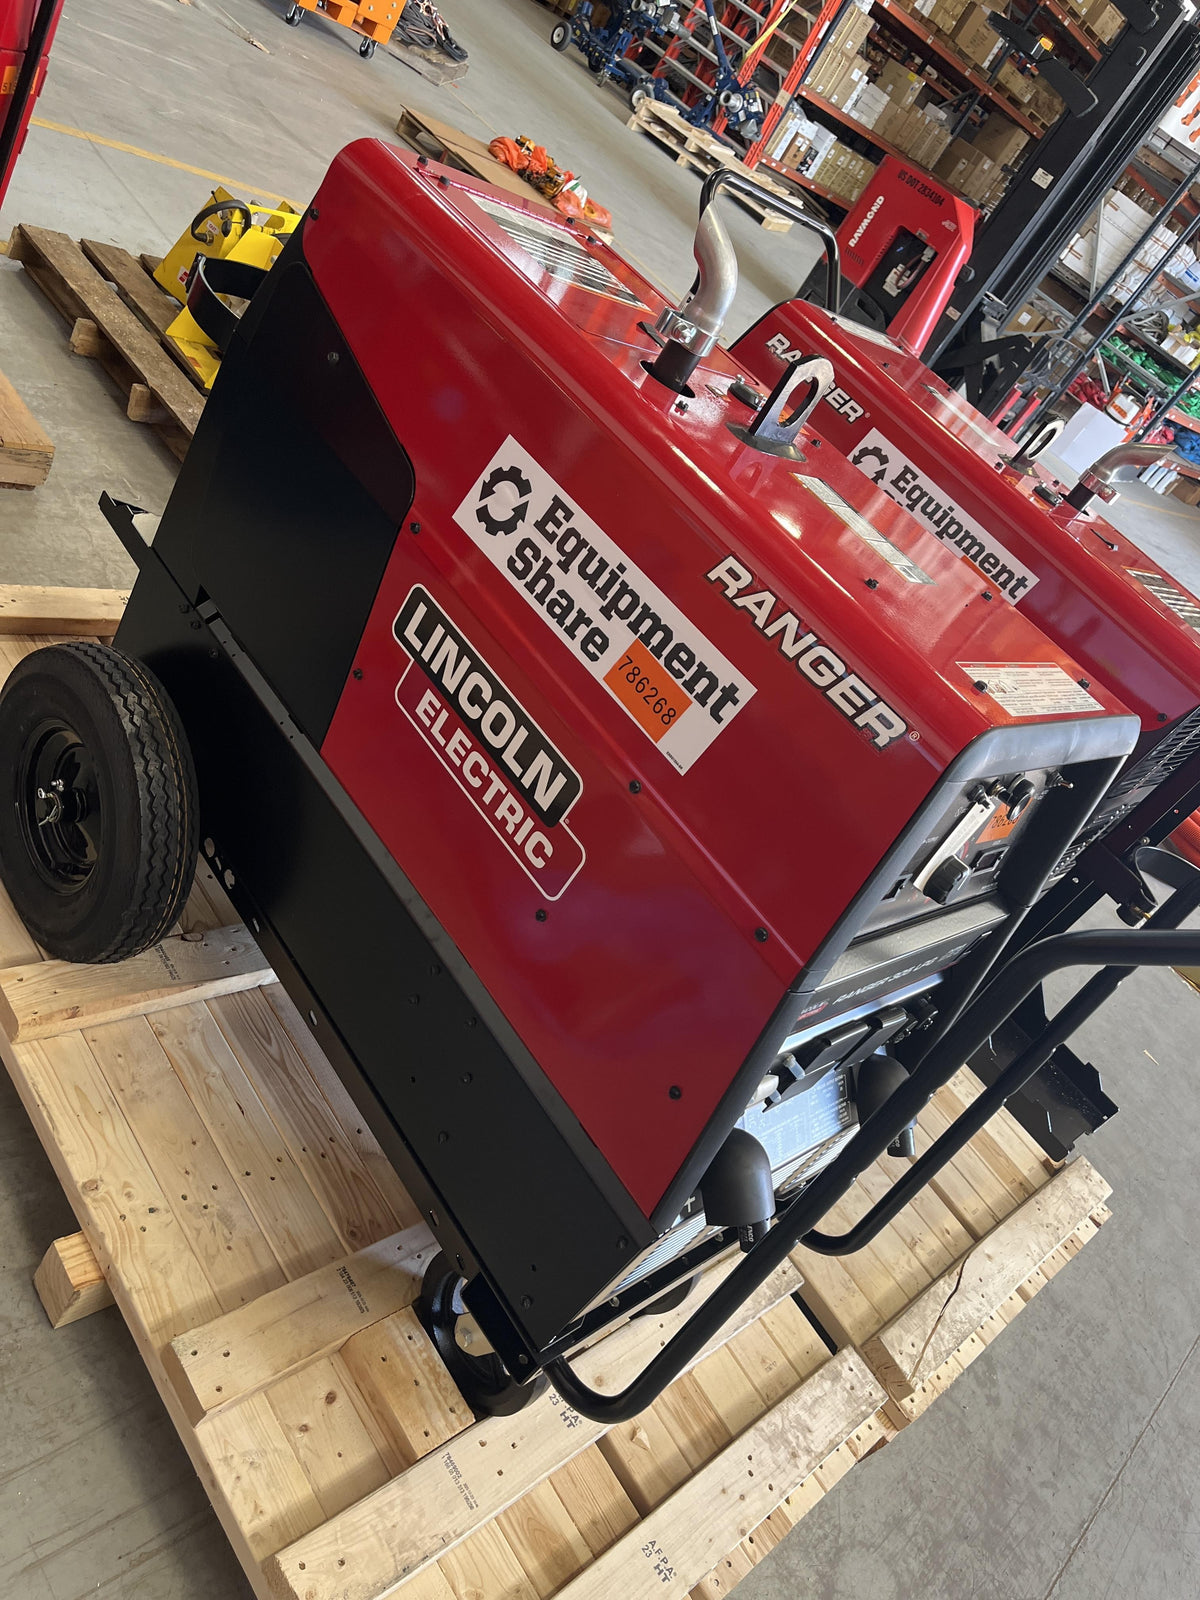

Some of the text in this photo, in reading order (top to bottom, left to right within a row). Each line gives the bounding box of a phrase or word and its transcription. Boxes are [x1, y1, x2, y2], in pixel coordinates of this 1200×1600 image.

[848, 195, 885, 248] RAYMOND
[906, 175, 920, 190] DOT
[765, 333, 865, 424] RAER
[890, 464, 1029, 600] Equipment
[507, 538, 609, 662] Share
[534, 494, 740, 725] Equipment
[404, 602, 568, 811] LINCOLN
[618, 655, 677, 726] 786268
[415, 688, 553, 869] ELECTRIC
[549, 1393, 576, 1428] 23 HT
[641, 1544, 671, 1583] 23 HT
